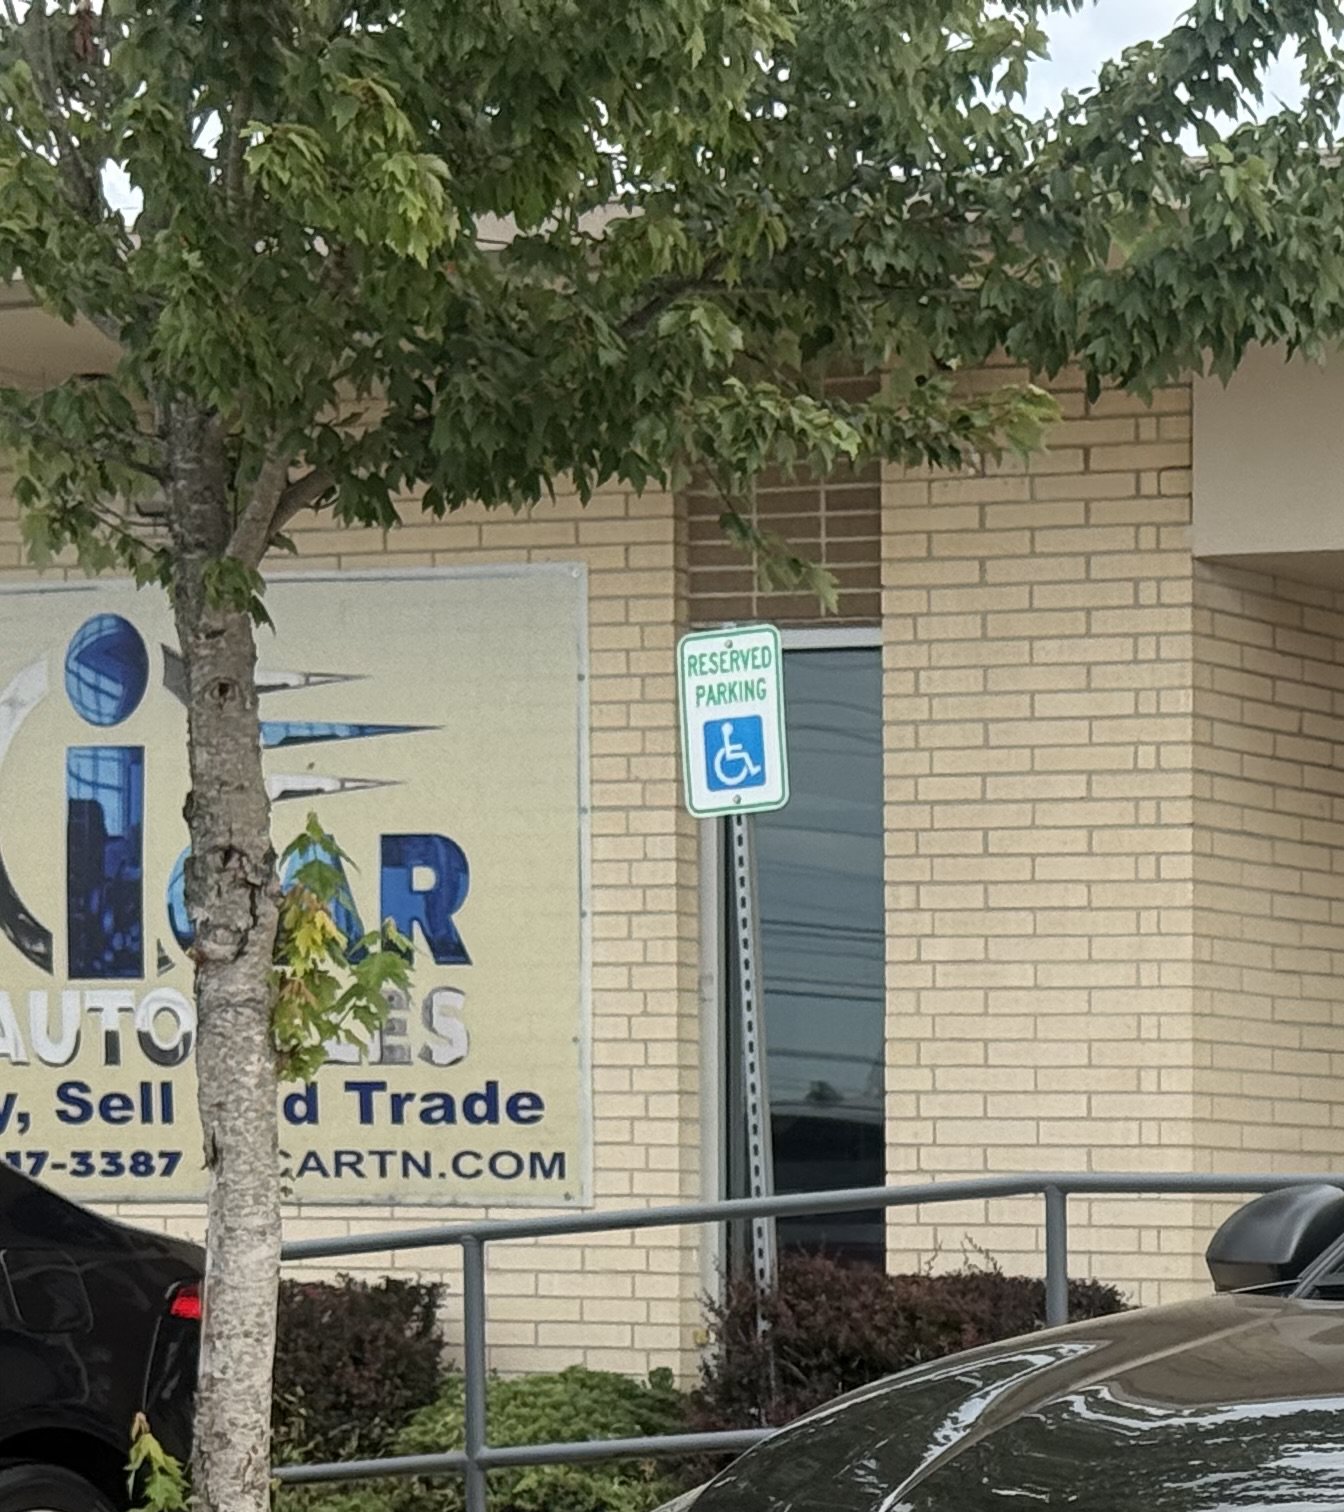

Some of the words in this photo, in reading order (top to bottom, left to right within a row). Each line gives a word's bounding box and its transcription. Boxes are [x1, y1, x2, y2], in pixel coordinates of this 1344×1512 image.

[687, 646, 772, 677] RESERVED
[695, 678, 767, 707] PARKING
[55, 1080, 175, 1125] Sell
[344, 1080, 545, 1125] Trade
[5, 1151, 183, 1178] 17-3387
[279, 1149, 567, 1180] ARTN.COM
